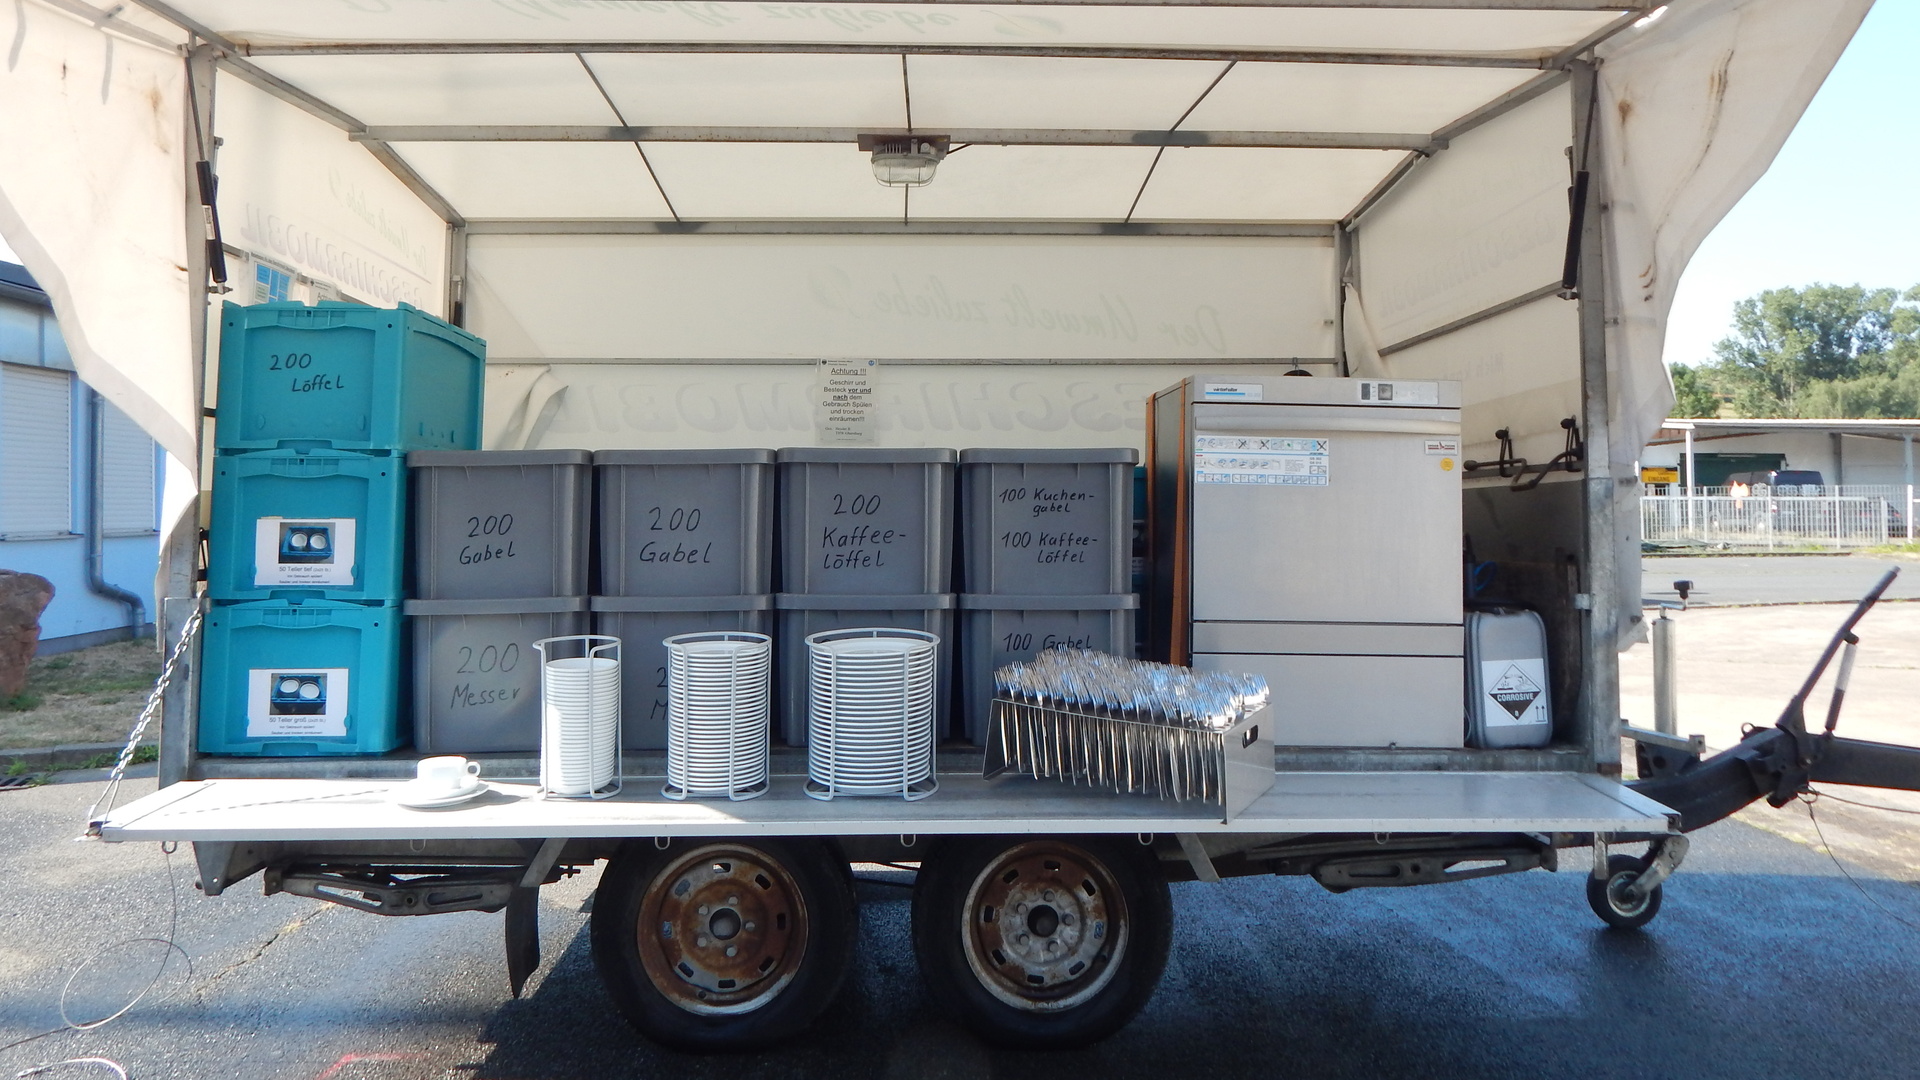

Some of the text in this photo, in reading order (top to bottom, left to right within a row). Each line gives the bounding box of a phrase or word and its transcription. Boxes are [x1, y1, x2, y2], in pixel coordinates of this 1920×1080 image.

[269, 353, 313, 371] 200
[831, 367, 858, 375] Achtung
[292, 374, 345, 392] Löffel
[833, 493, 881, 515] 200
[999, 488, 1095, 504] 100 Kuchen-
[648, 507, 701, 531] 200
[1033, 503, 1071, 517] gabel
[467, 514, 514, 538] 200
[822, 525, 906, 548] Kaffee-
[1001, 531, 1098, 548] 100 Kaffee-
[459, 541, 516, 565] Gabel
[639, 541, 712, 564] Gabel
[1003, 633, 1033, 652] 100
[456, 643, 520, 674] 200
[450, 683, 521, 709] Messer
[1497, 692, 1535, 702] CORROSIVE
